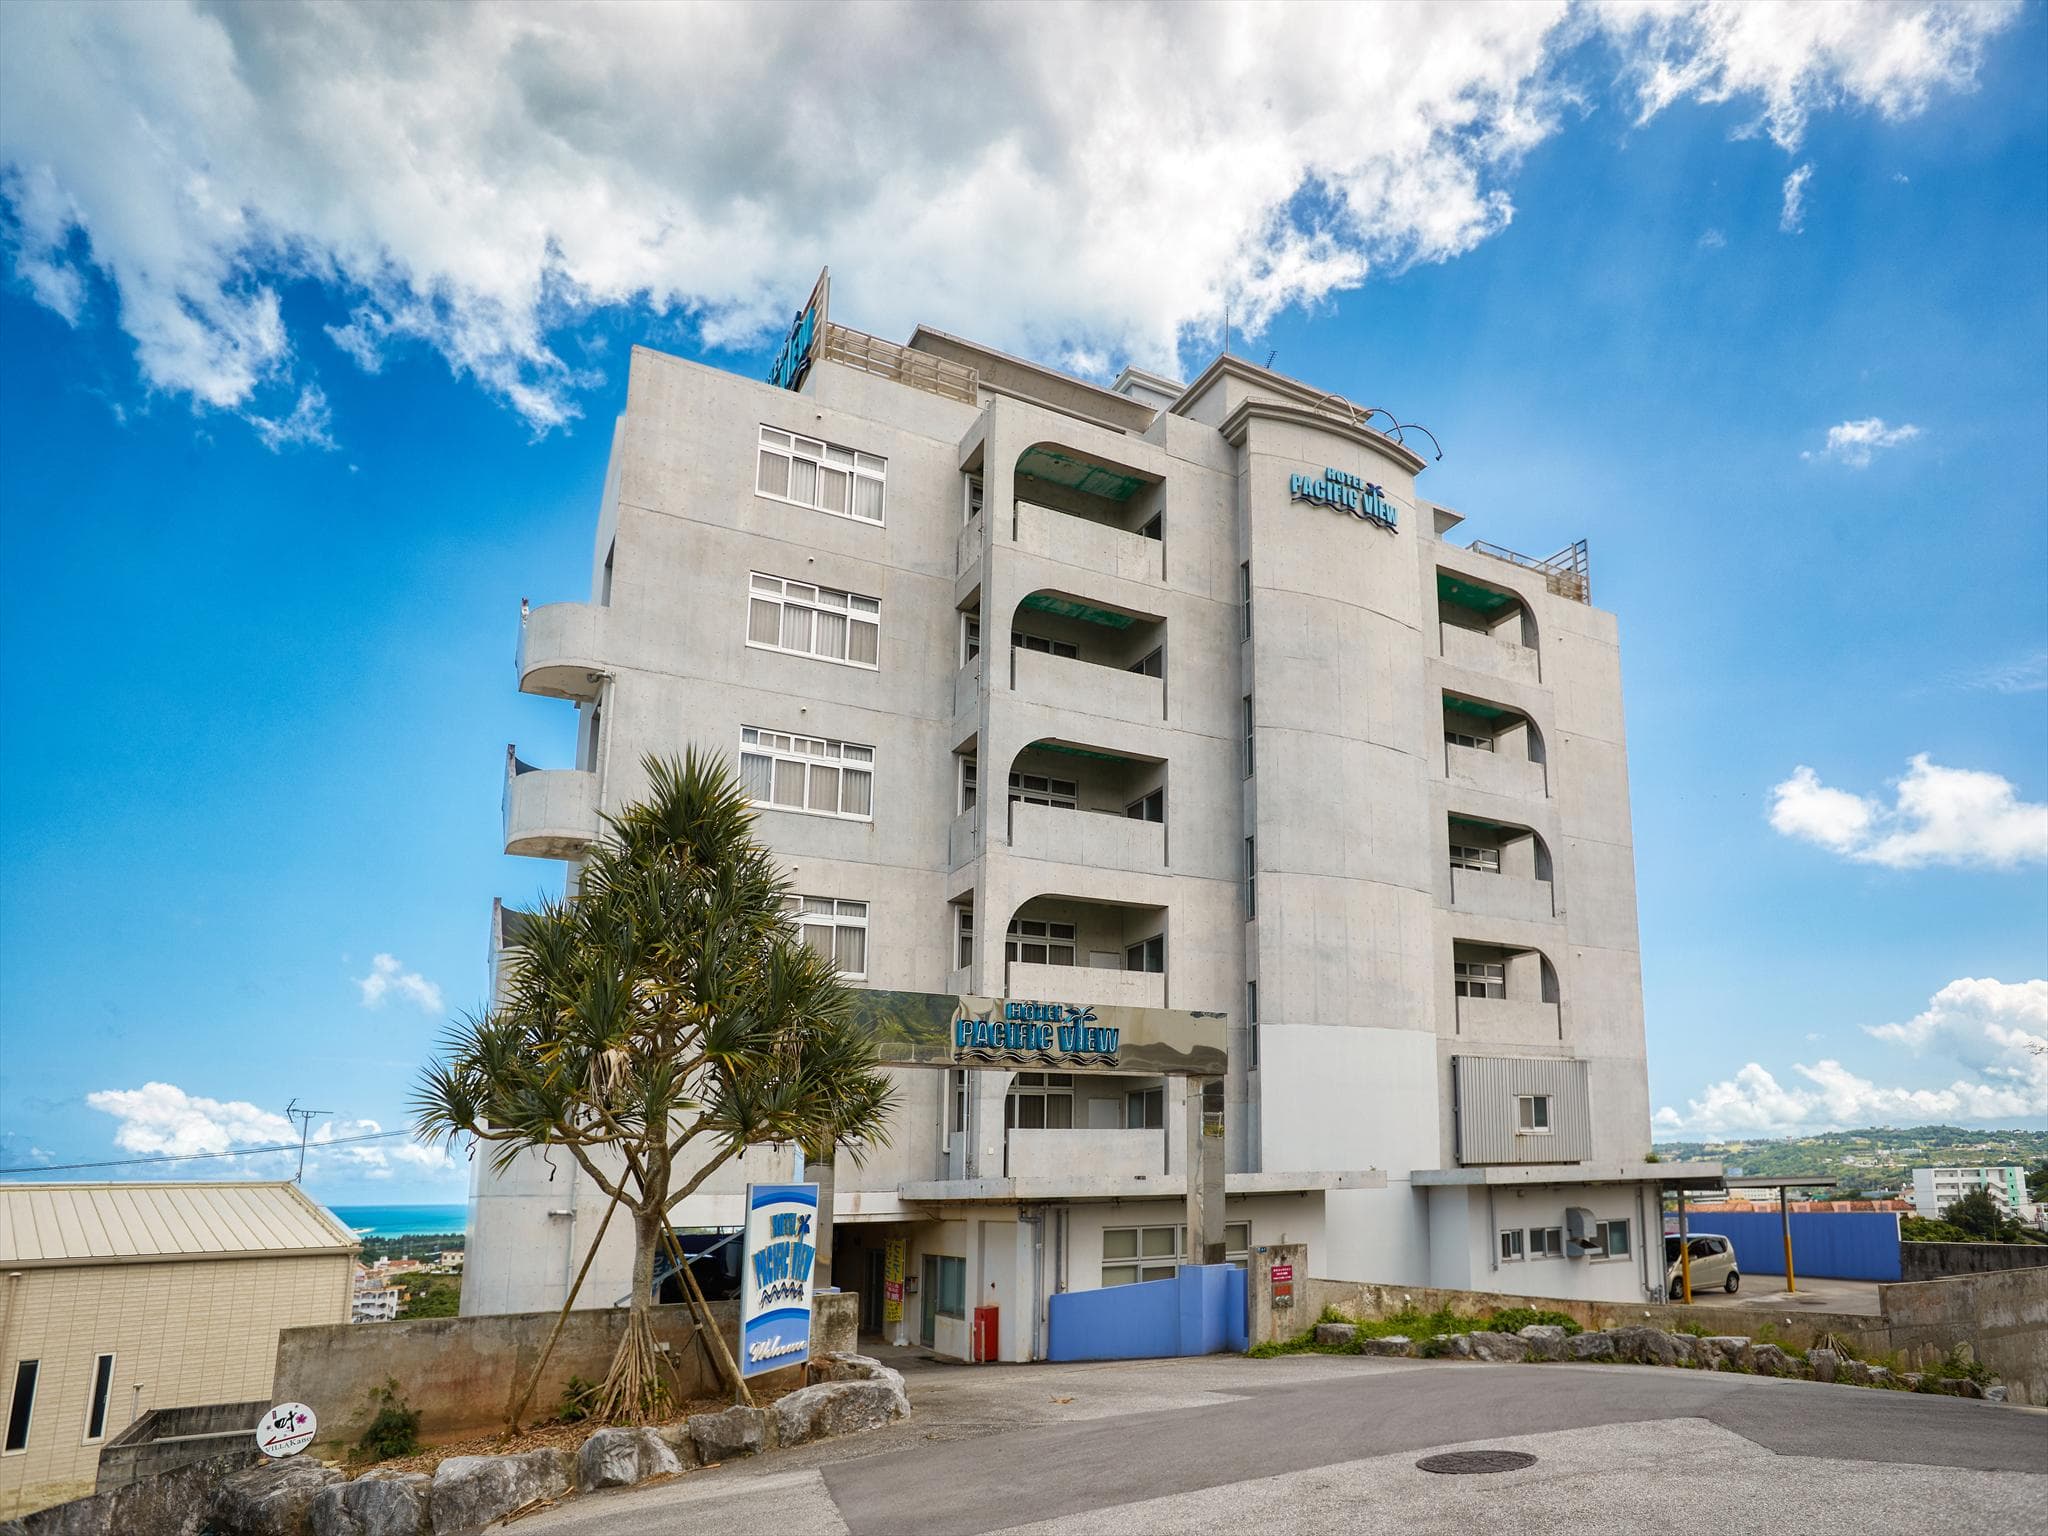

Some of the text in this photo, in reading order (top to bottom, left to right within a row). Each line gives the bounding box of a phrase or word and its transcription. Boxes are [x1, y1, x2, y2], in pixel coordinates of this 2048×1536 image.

[1325, 467, 1364, 491] HOTEL
[1291, 473, 1399, 526] PACIFIC VIEW
[1006, 1002, 1063, 1022] HOTEL
[957, 1016, 1119, 1053] PACIFIC VIEW
